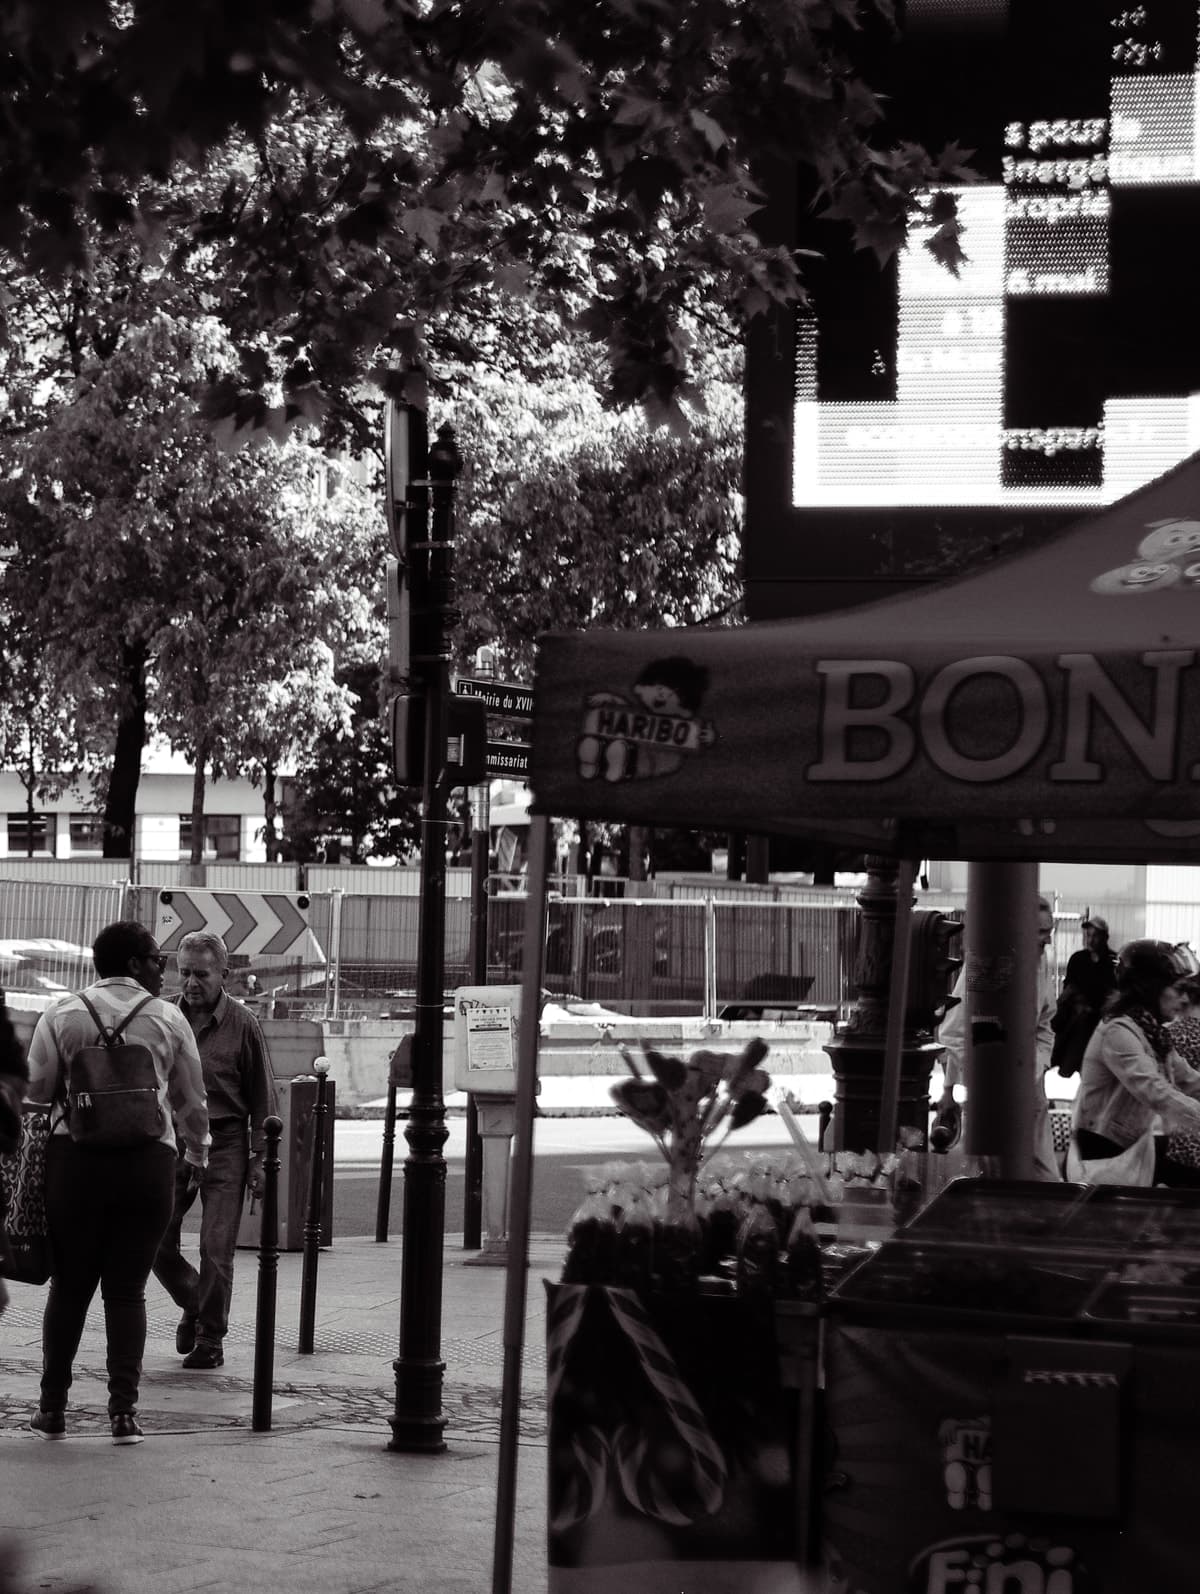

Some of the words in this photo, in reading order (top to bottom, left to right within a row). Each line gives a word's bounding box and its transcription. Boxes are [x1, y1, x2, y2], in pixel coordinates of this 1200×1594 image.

[1028, 118, 1108, 152] pour
[502, 693, 513, 709] du
[803, 648, 1200, 784] BON
[598, 709, 691, 746] HARIBO
[485, 751, 529, 769] missariat
